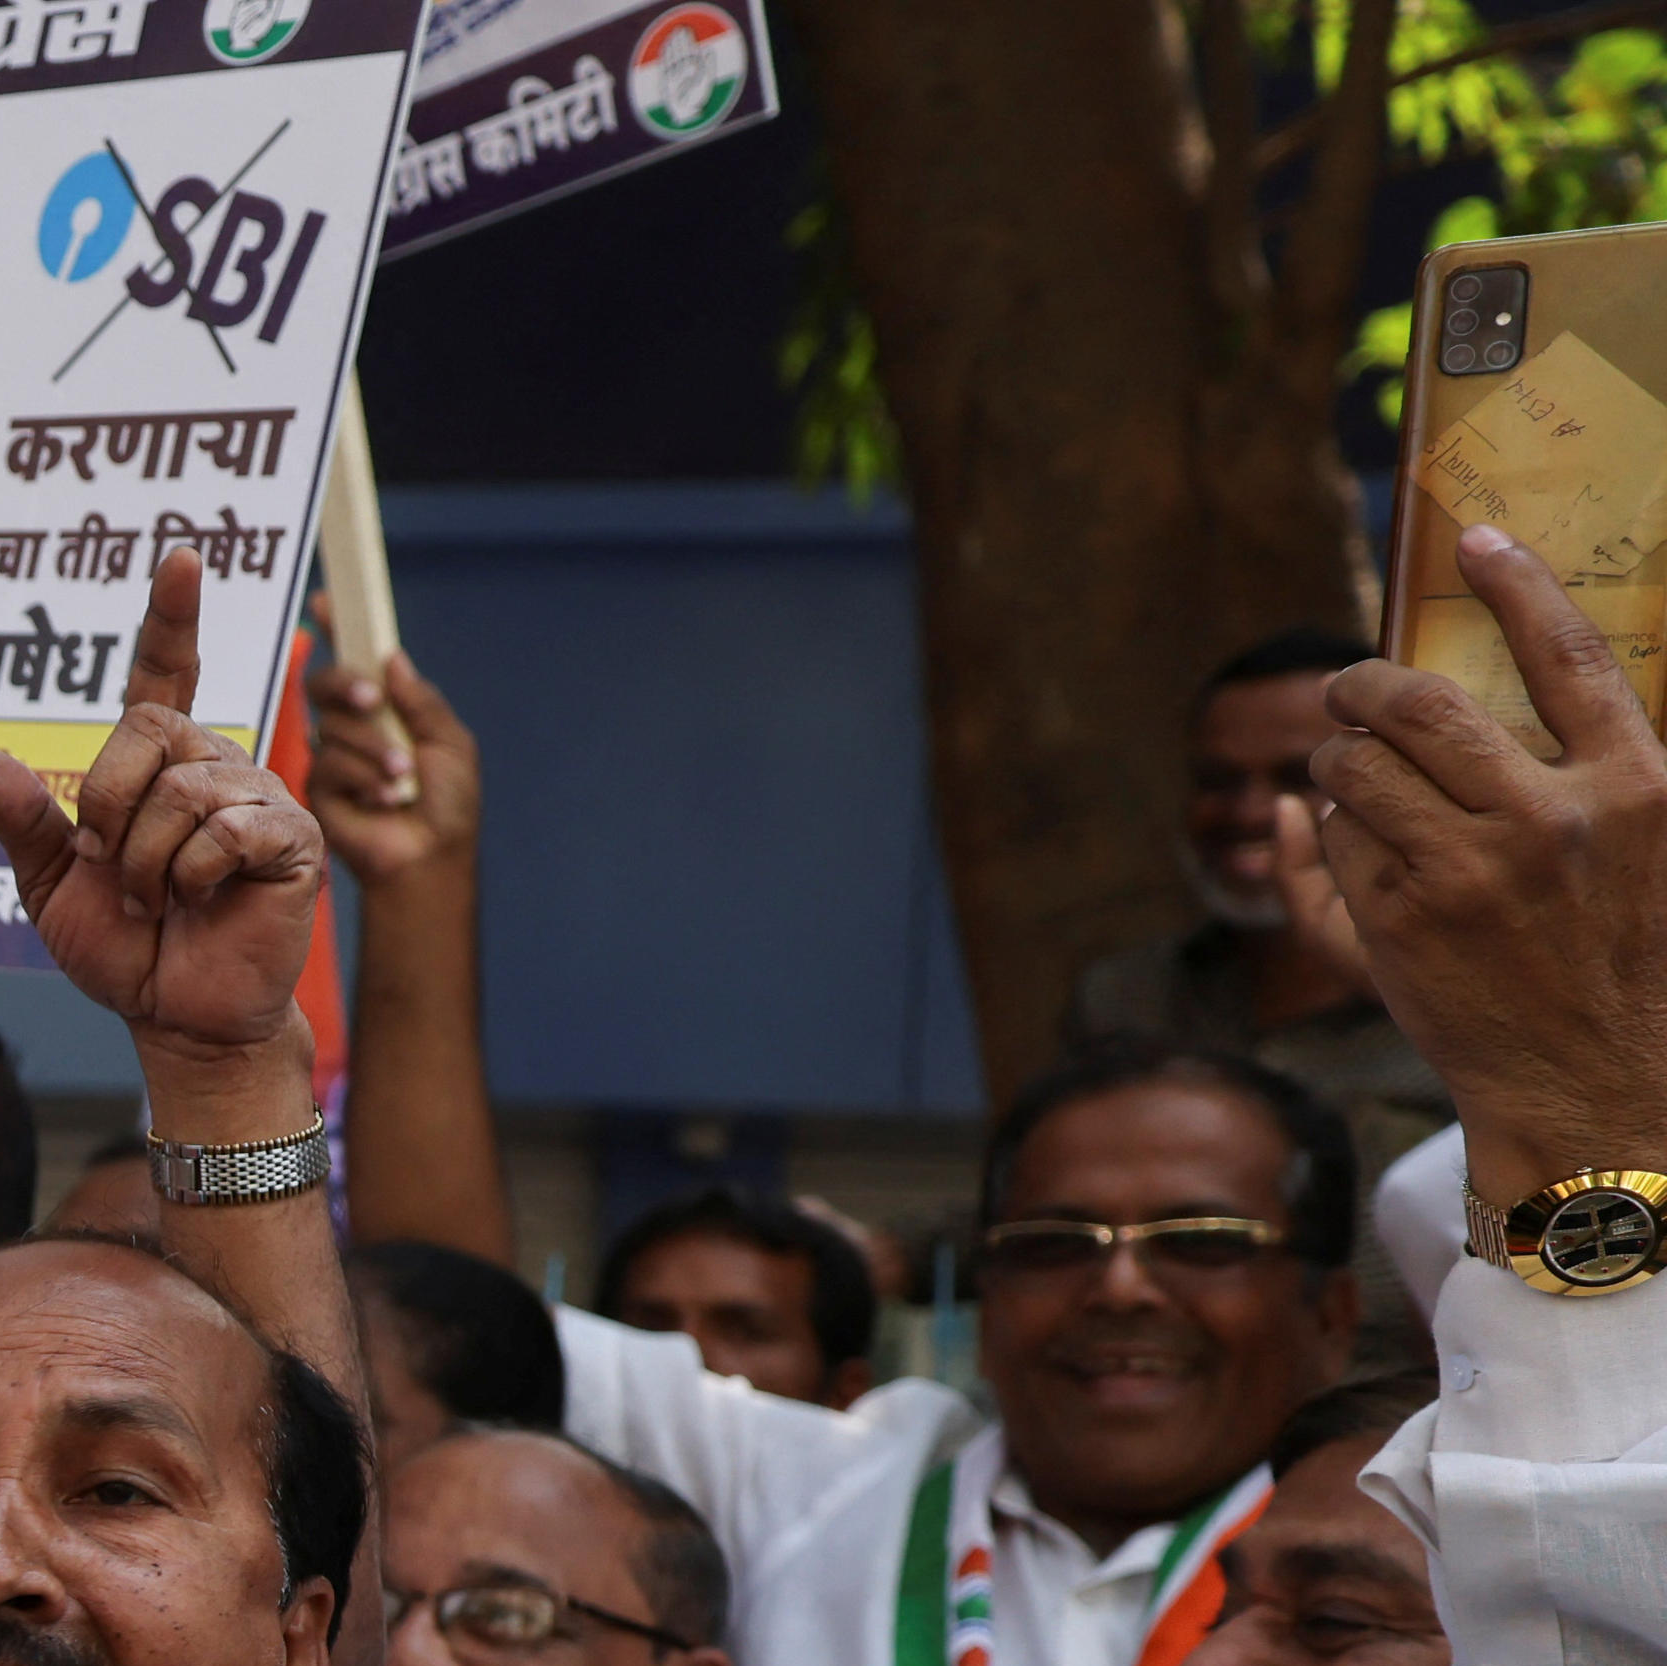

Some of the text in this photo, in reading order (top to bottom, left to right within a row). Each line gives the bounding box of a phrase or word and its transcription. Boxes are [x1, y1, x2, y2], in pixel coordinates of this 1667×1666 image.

[465, 54, 619, 175] कमिटी
[125, 175, 327, 345] SBI
[54, 510, 141, 585] तीव्र
[147, 504, 285, 581] िषेध
